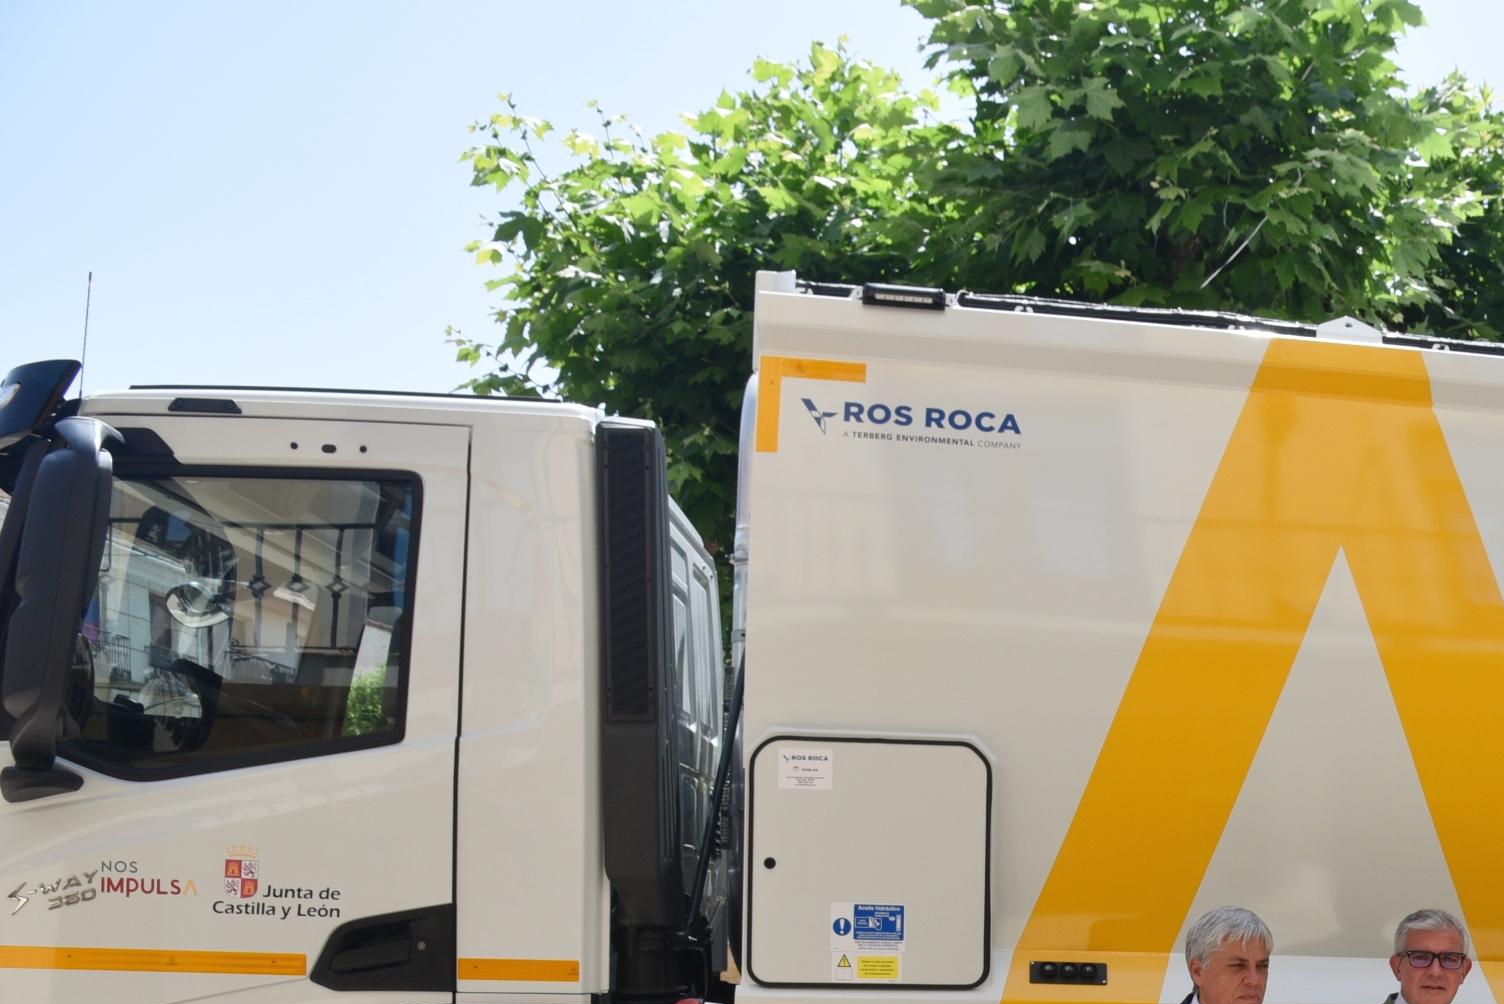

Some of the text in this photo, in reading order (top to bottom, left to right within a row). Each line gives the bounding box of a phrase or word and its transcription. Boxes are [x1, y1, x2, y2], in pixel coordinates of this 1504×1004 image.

[843, 401, 1023, 435] ROS ROCA
[843, 430, 1022, 451] A TERBERG ENVIRONMENTAL COMPANY
[101, 860, 138, 873] NOS
[262, 885, 341, 901] Junta de
[212, 901, 341, 920] Castilla y León
